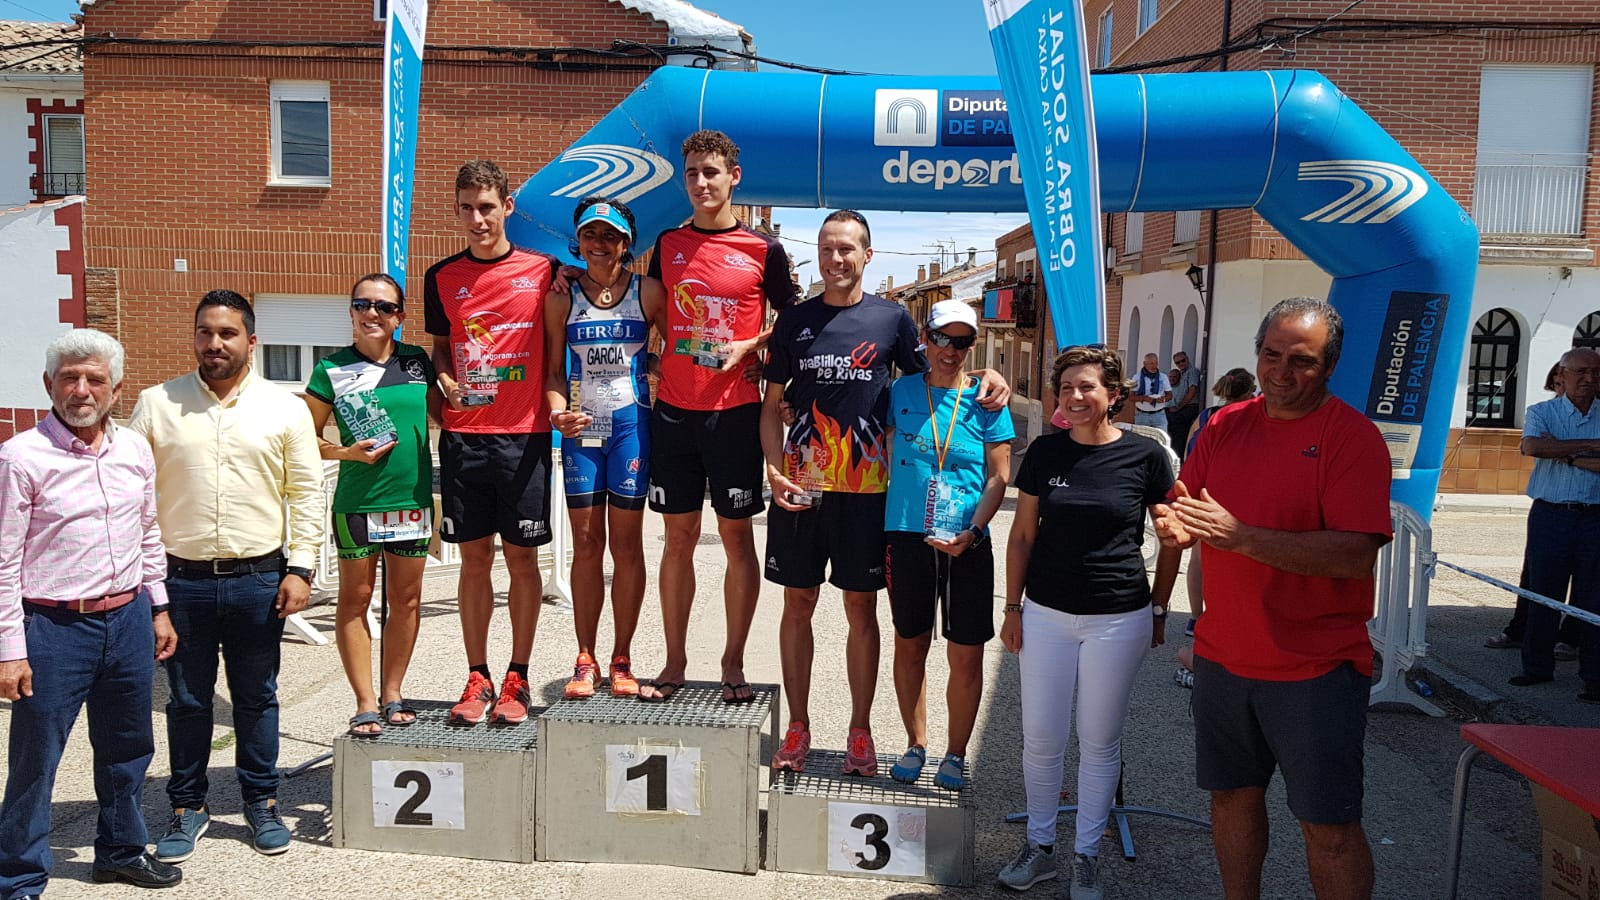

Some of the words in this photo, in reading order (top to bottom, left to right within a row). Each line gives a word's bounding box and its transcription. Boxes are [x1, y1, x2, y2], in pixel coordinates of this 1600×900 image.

[948, 97, 1008, 116] Diputa
[948, 119, 976, 135] DE
[982, 119, 1013, 135] PA
[882, 150, 1023, 191] deport
[392, 172, 401, 268] OBRA
[576, 323, 635, 340] FERROL
[1407, 298, 1441, 388] PALENCIA
[587, 346, 625, 366] GARCIA
[1376, 319, 1413, 415] Diputación
[334, 396, 365, 440] RIATLON
[1401, 393, 1420, 417] DE
[1047, 475, 1070, 488] eli
[924, 479, 938, 529] TRIATLON
[393, 769, 433, 826] 2
[626, 754, 668, 811] 1
[850, 813, 891, 871] 3
